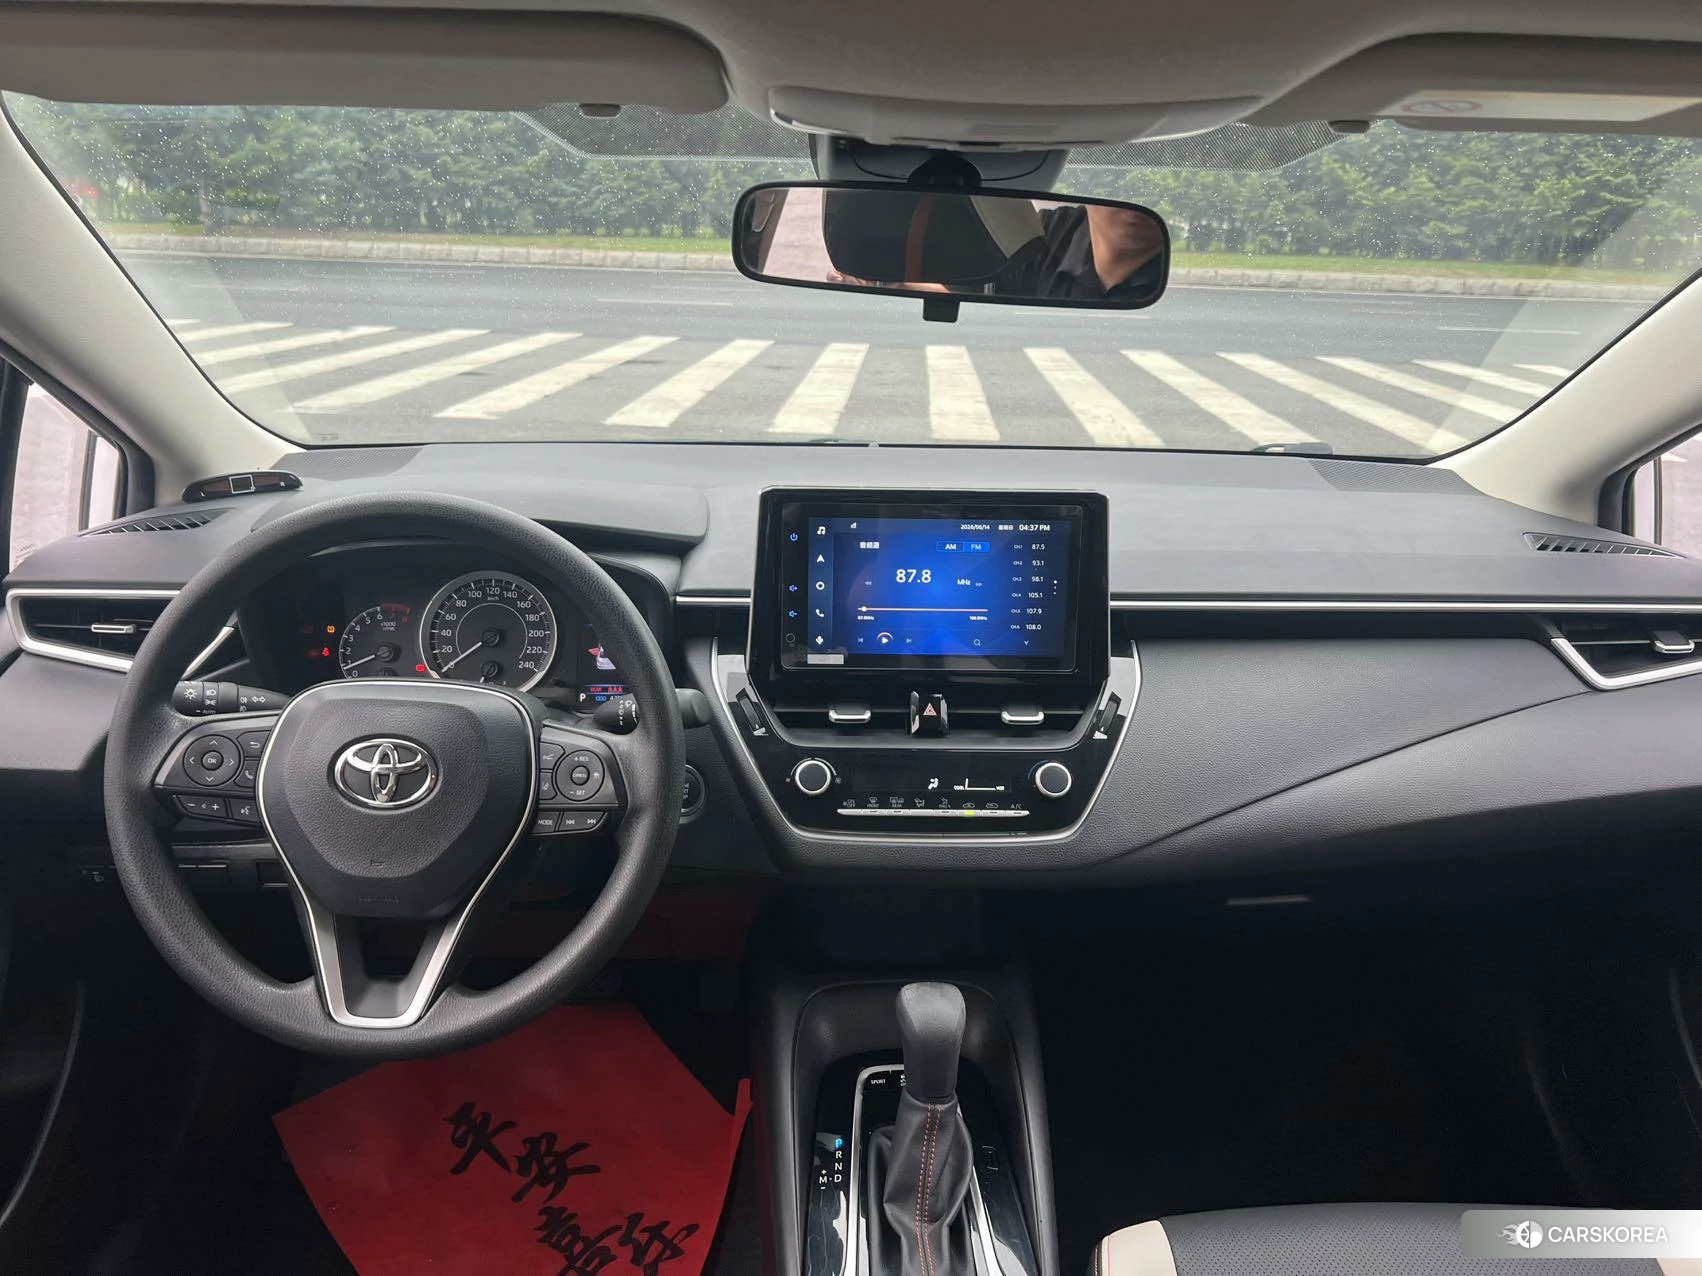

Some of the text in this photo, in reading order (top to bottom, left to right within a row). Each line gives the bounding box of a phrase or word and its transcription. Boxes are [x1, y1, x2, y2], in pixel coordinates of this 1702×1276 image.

[1018, 524, 1038, 532] 04:37
[1039, 524, 1051, 532] PM
[896, 568, 932, 584] 87.8
[468, 590, 482, 598] 100
[486, 587, 500, 595] 120
[376, 612, 383, 620] 6
[445, 613, 457, 621] 60
[525, 614, 540, 622] 180
[365, 616, 371, 625] 5
[354, 624, 361, 632] 4
[441, 629, 452, 637] 40
[348, 634, 354, 642] 3
[345, 647, 352, 655] 2
[441, 645, 453, 653] 20
[526, 646, 543, 654] 220
[518, 661, 535, 669] 240
[579, 693, 586, 702] P
[835, 1138, 843, 1148] P
[836, 1151, 842, 1159] R
[834, 1162, 843, 1171] N
[819, 1174, 842, 1184] M D
